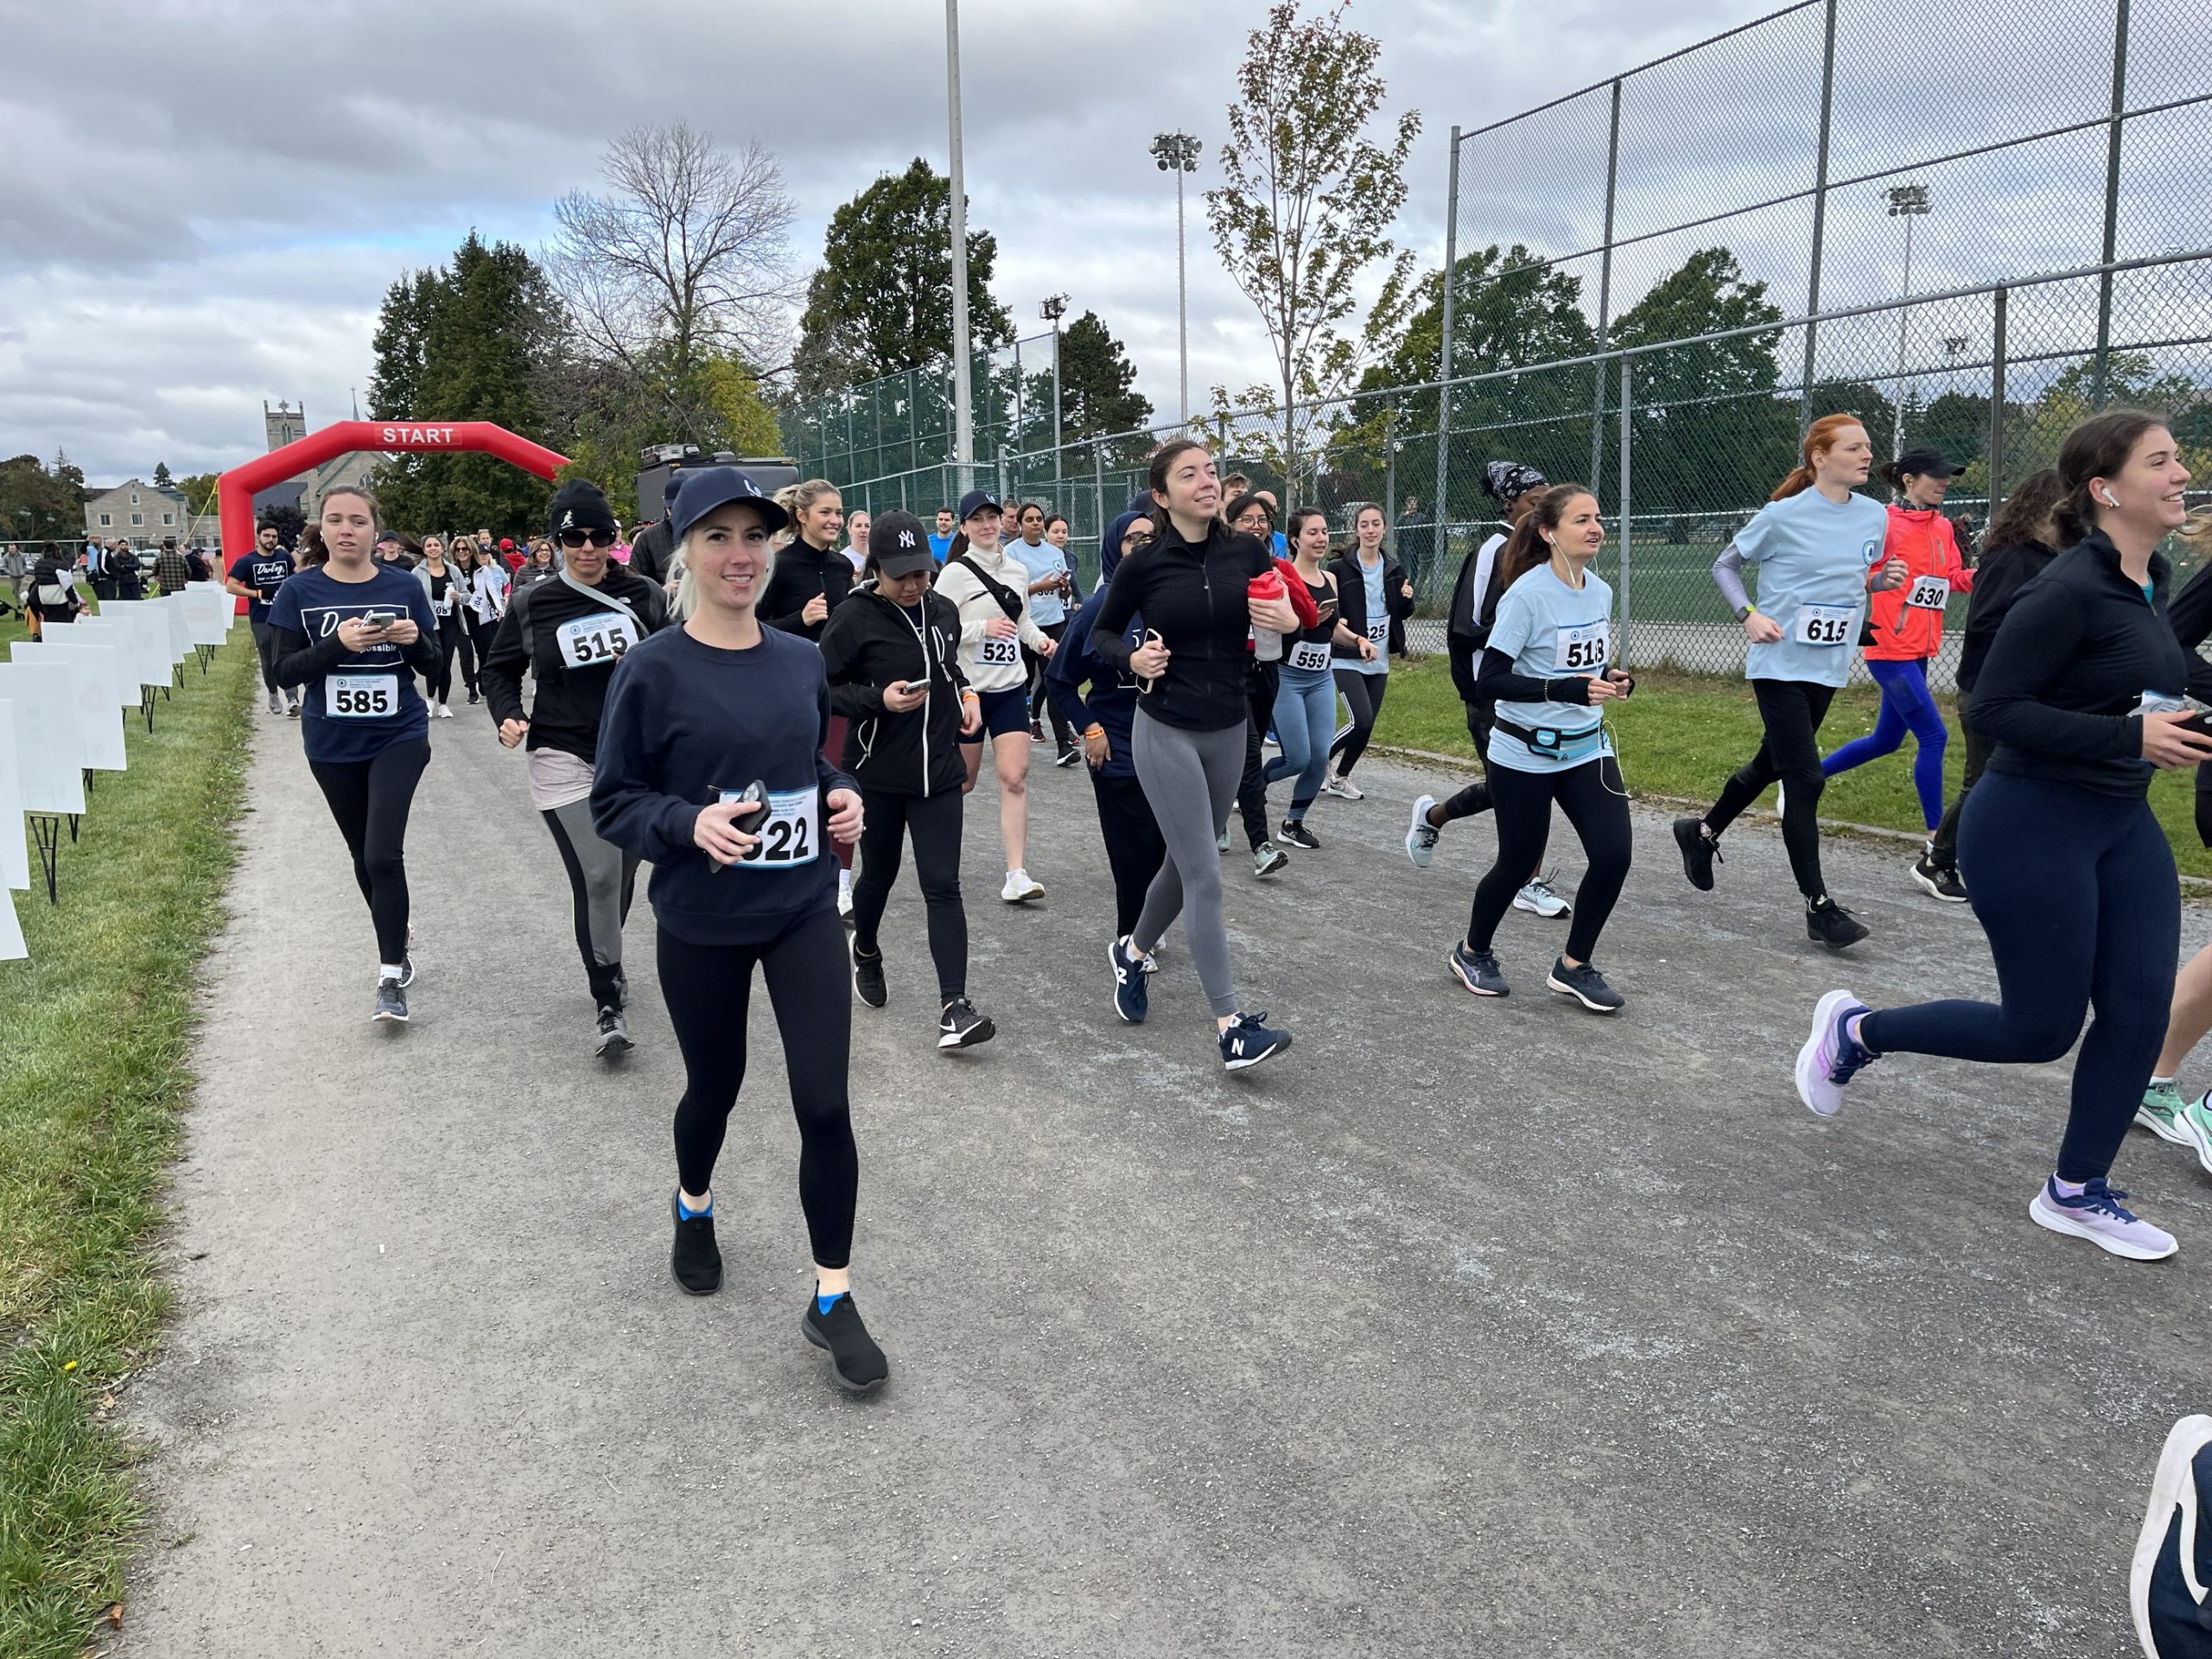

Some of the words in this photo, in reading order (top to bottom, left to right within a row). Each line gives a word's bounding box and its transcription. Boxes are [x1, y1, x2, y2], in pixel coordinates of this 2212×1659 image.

[383, 428, 454, 443] START
[1914, 586, 1944, 607] 630
[1366, 624, 1386, 639] 25
[1807, 619, 1849, 642] 615
[359, 644, 397, 654] ossible
[572, 627, 628, 662] 515
[982, 642, 1016, 663] 523
[1567, 638, 1605, 668] 518
[1296, 651, 1325, 669] 559
[336, 690, 388, 714] 585
[1230, 1038, 1245, 1056] N
